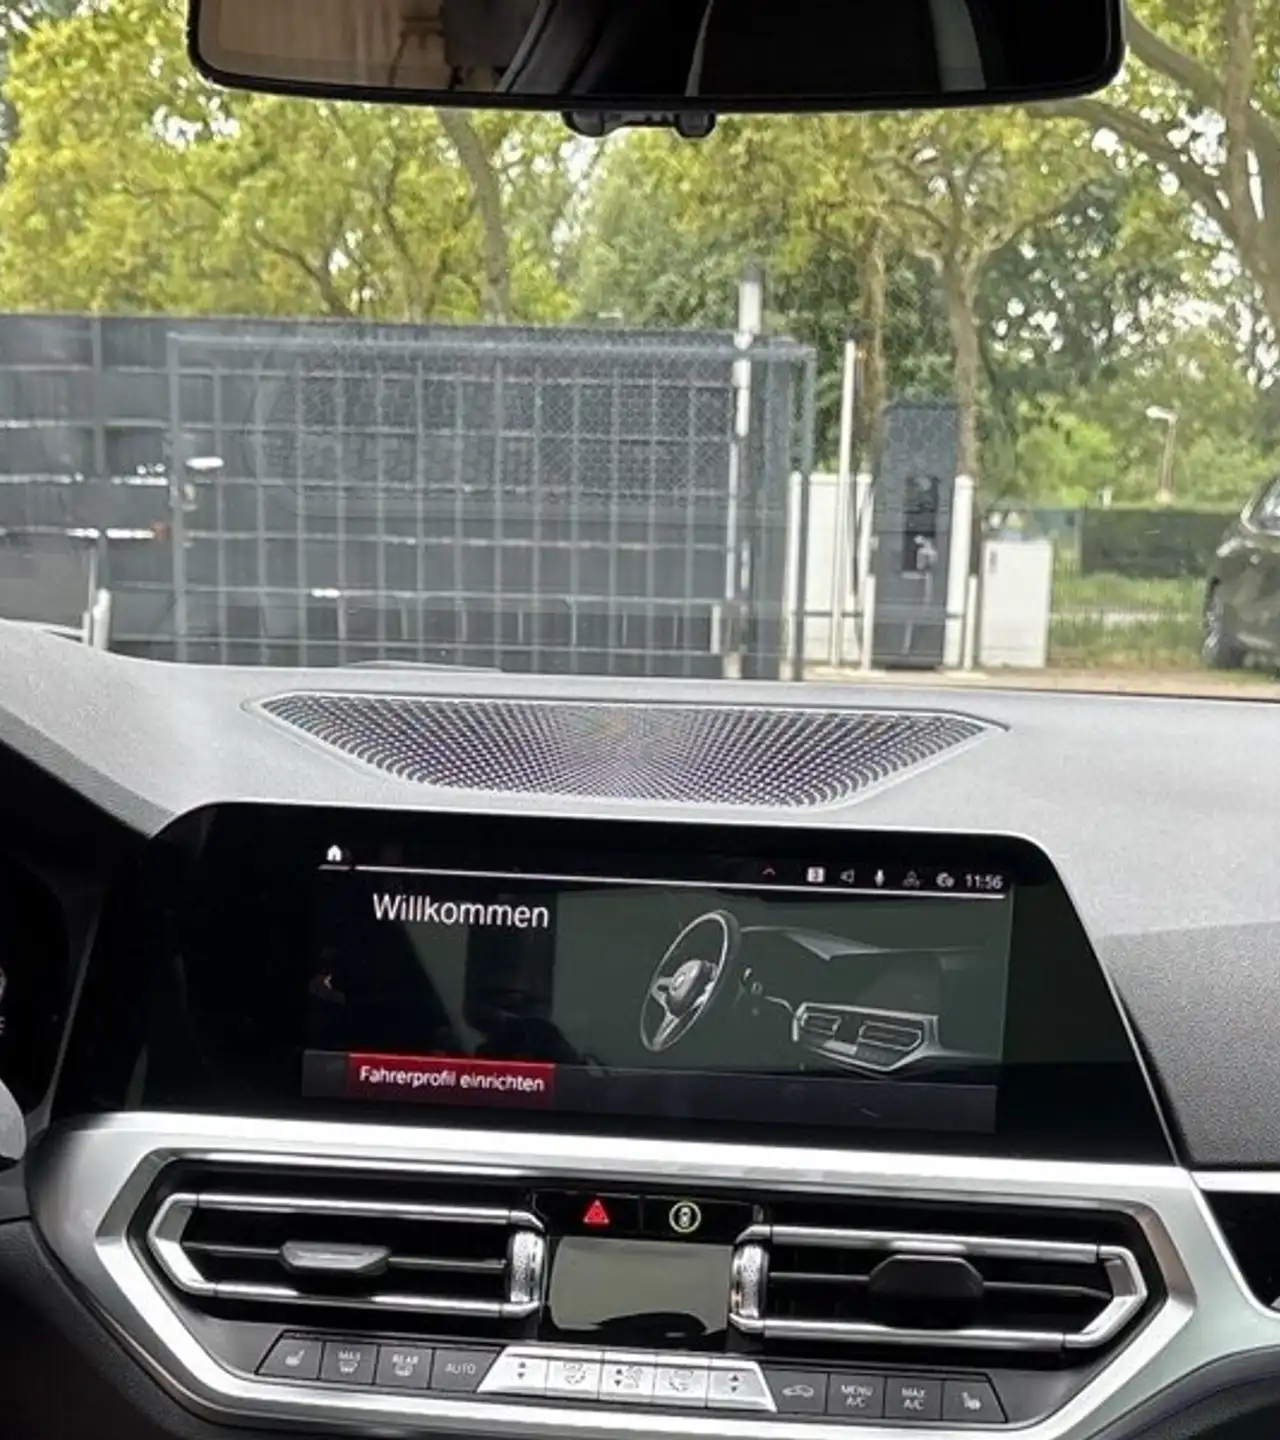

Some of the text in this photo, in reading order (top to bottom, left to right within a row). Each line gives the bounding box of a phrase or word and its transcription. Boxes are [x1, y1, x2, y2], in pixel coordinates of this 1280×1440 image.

[965, 873, 1003, 889] 11:56
[373, 893, 549, 928] Willkommen
[360, 1066, 545, 1092] Fahrerprofil einrichten
[445, 1363, 476, 1374] AUTO
[841, 1385, 873, 1396] MENU
[901, 1388, 926, 1398] MAX
